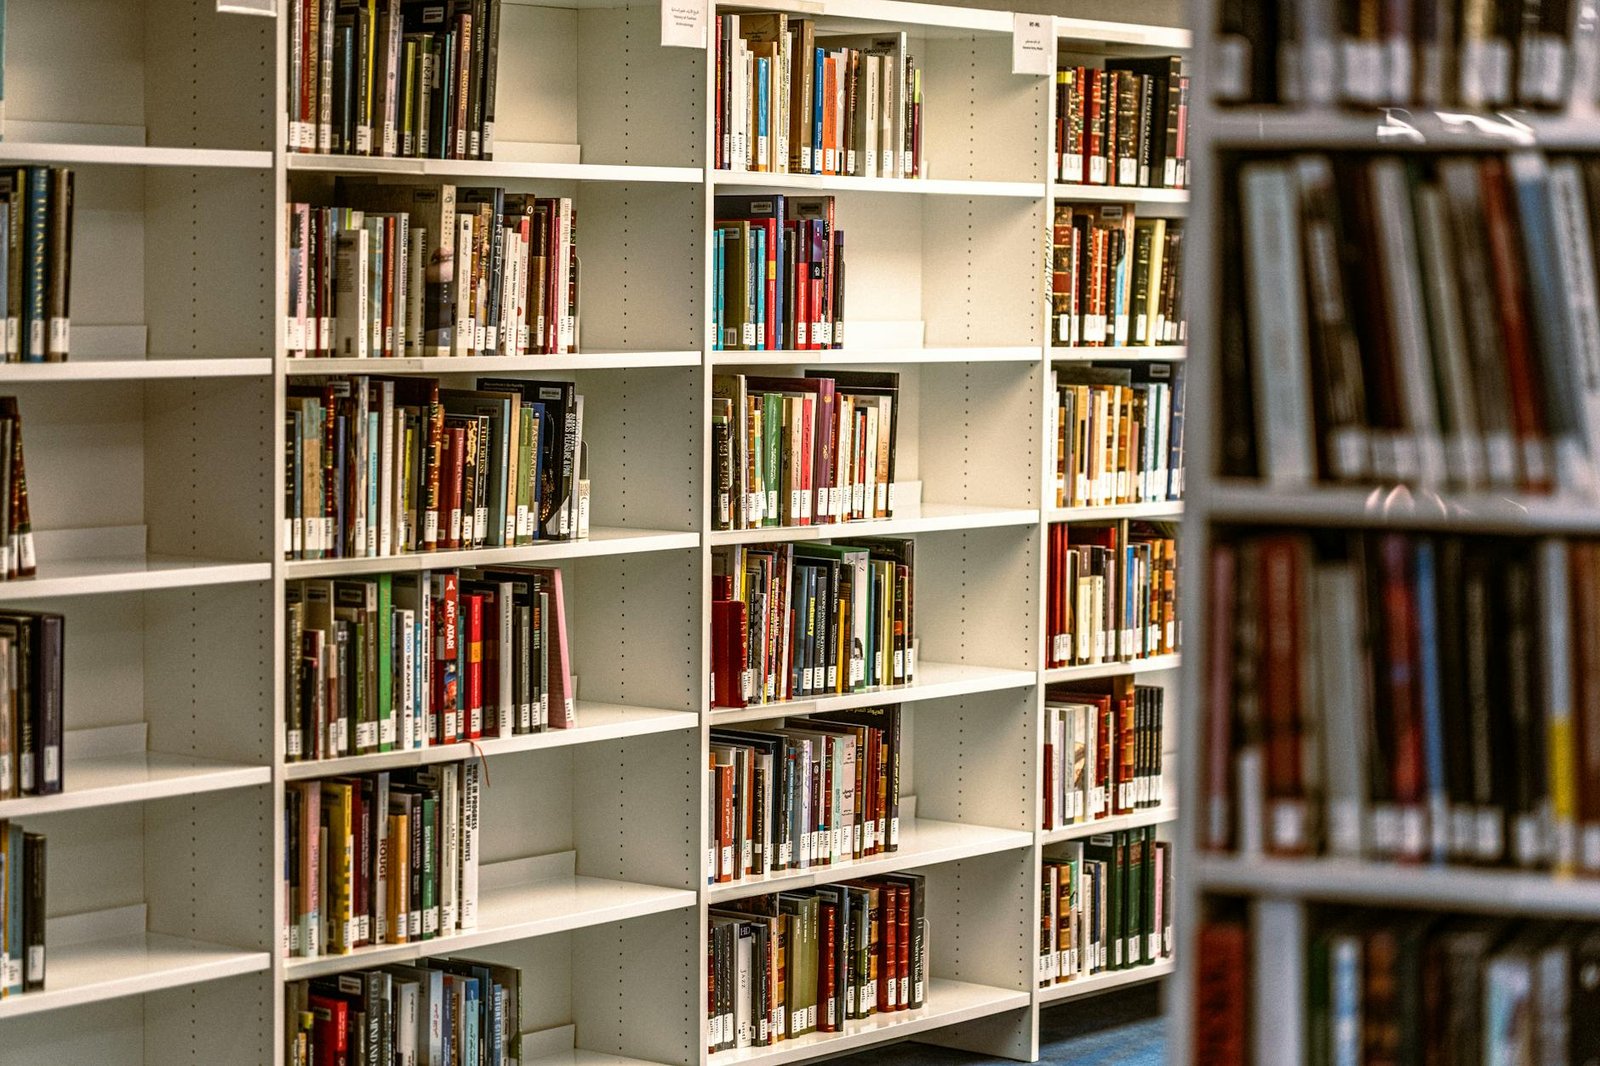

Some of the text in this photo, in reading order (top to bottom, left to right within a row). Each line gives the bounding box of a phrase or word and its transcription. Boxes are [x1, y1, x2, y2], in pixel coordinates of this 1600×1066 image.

[322, 9, 333, 121] STEPPES
[461, 70, 469, 110] KNOWING
[35, 198, 46, 320] TUTANKHAMU
[493, 213, 504, 277] PREPPY
[565, 413, 573, 432] SHOES
[529, 425, 538, 487] FASCINATORS
[564, 434, 572, 460] PLEASURE
[446, 600, 454, 618] ART
[808, 597, 816, 636] Industry
[446, 624, 454, 650] ATARI
[379, 838, 387, 882] ROUGE
[370, 1018, 378, 1042] MIND
[370, 1044, 378, 1062] AND
